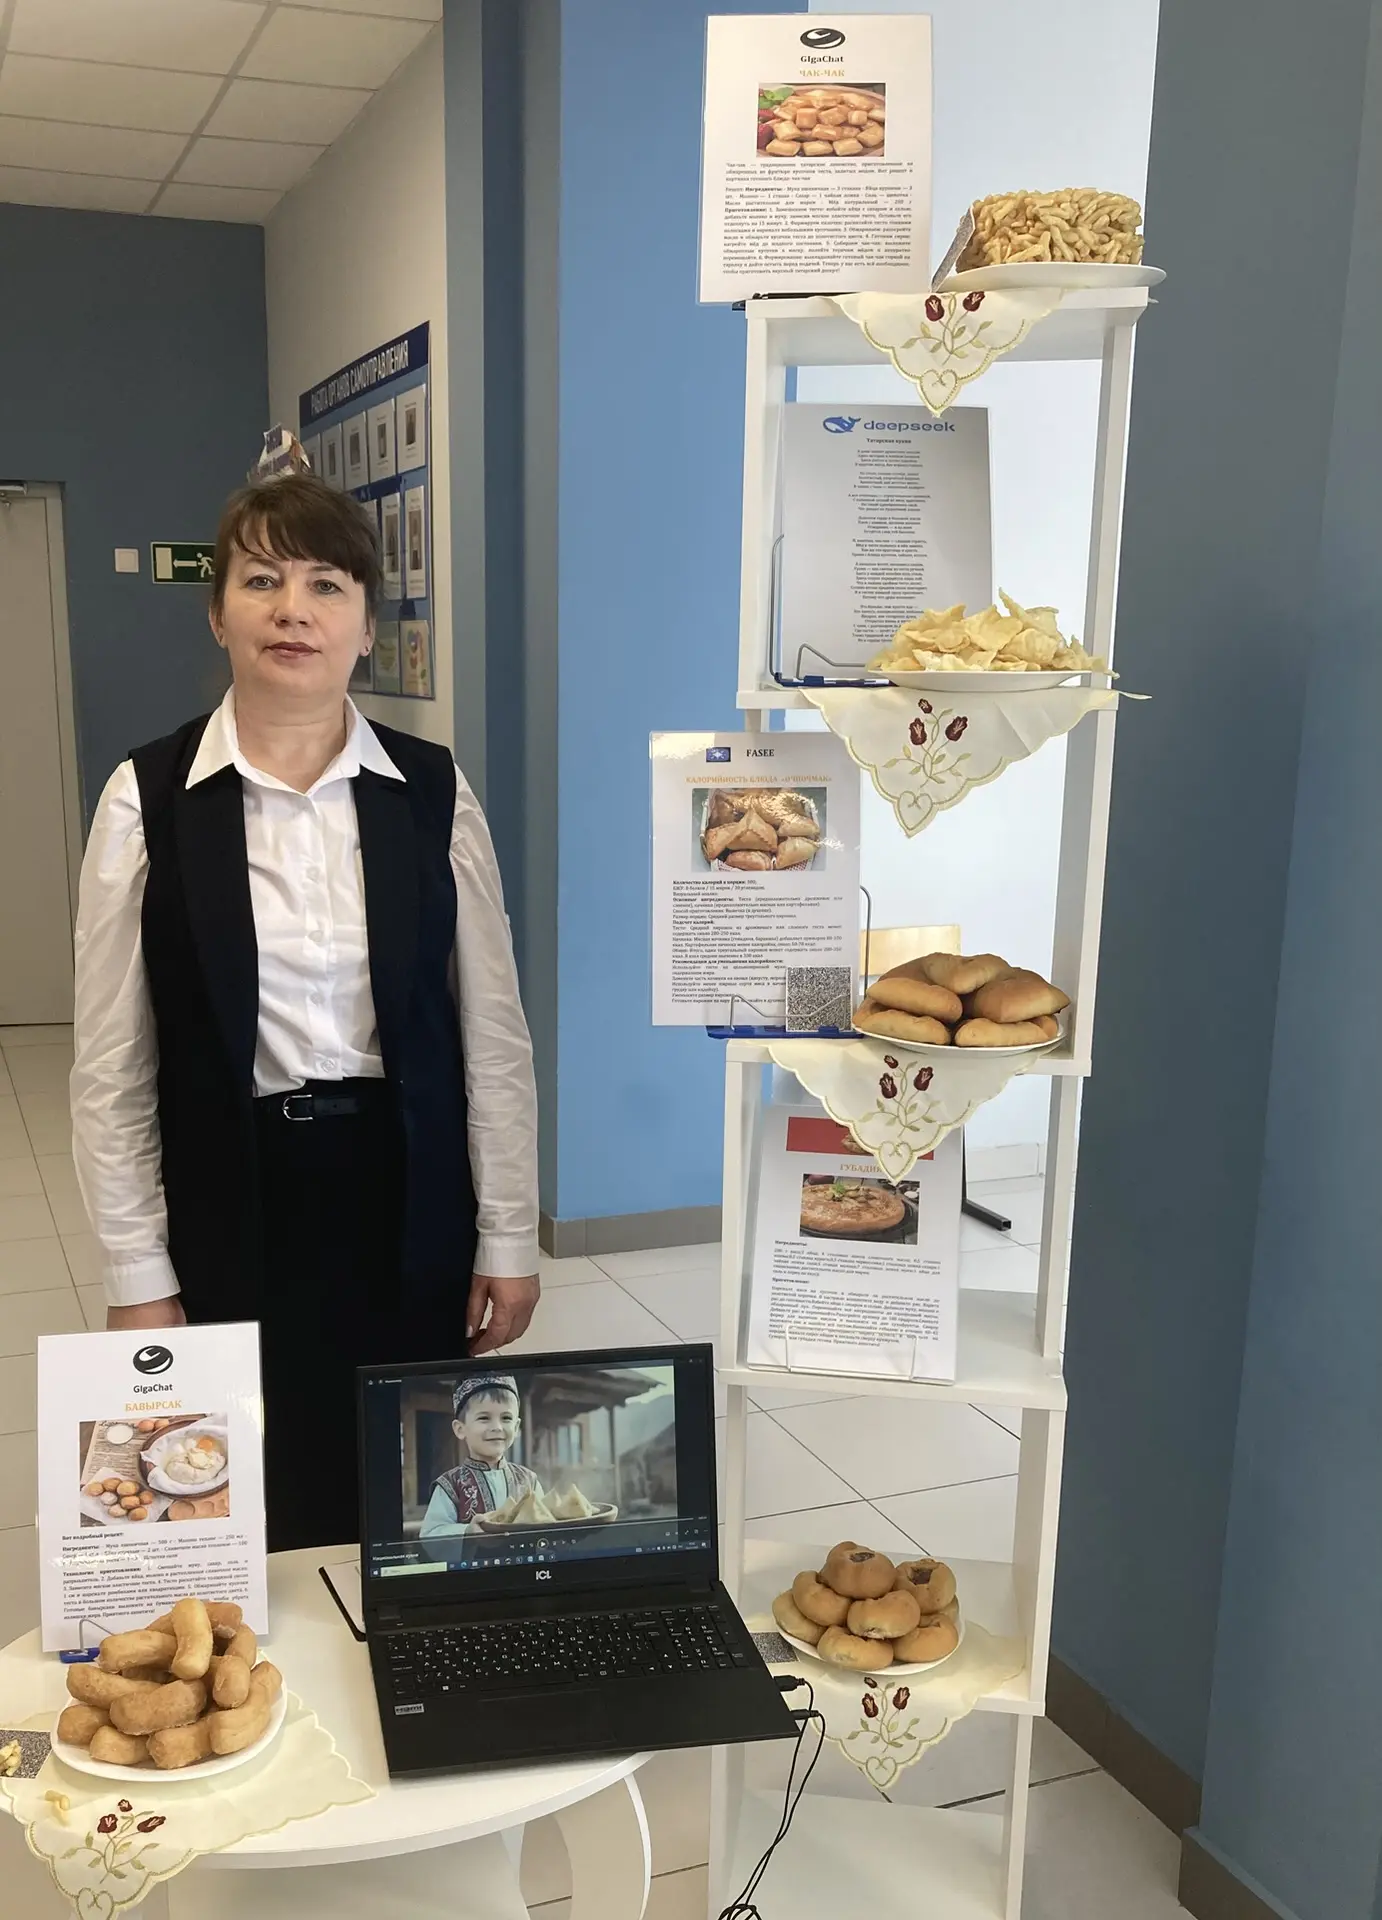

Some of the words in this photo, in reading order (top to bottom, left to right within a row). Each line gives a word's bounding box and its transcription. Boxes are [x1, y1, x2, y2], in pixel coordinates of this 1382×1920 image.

[864, 420, 955, 432] deepseek
[746, 749, 774, 757] FASEE
[133, 1383, 173, 1394] GIgaChat
[125, 1400, 182, 1412] БАВЫРСАК
[536, 1570, 551, 1580] ICL
